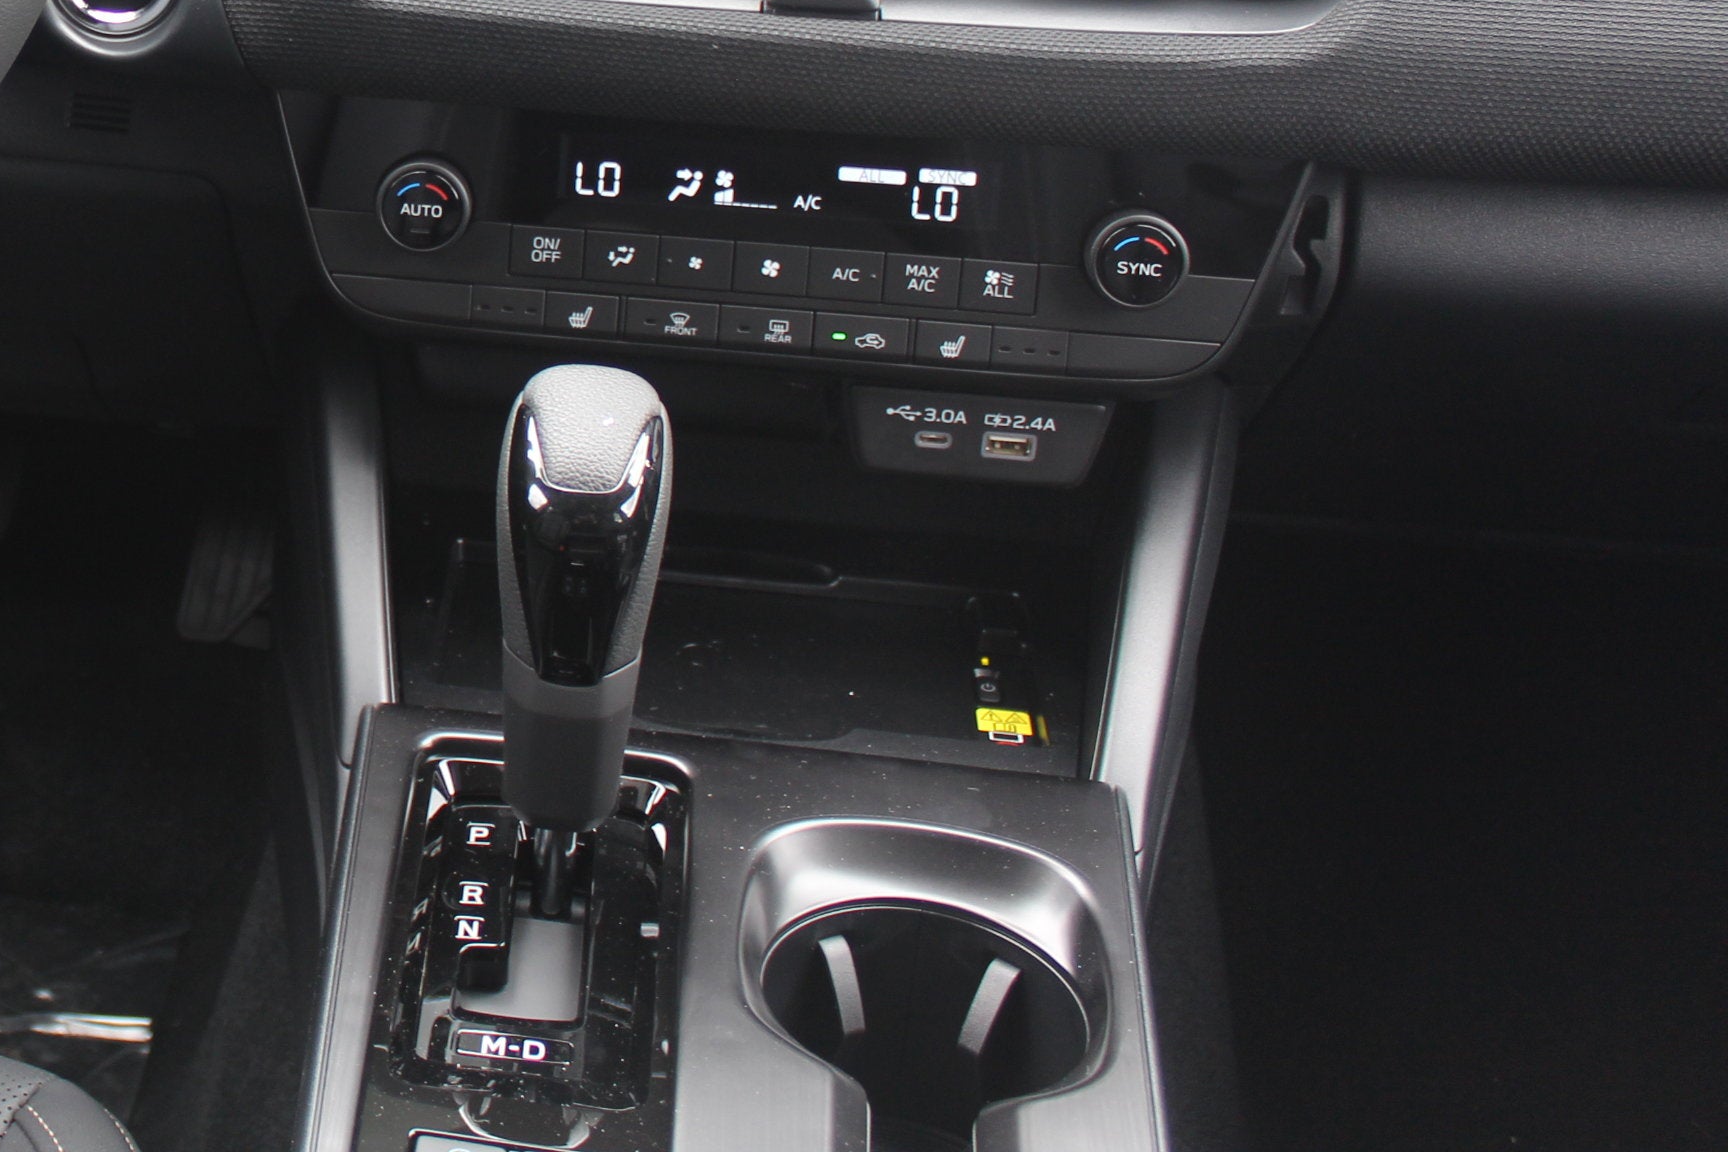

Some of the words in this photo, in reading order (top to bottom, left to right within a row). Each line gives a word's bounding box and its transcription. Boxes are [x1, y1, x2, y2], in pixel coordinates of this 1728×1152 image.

[793, 194, 822, 211] A/C
[400, 203, 443, 219] AUTO
[532, 236, 560, 251] ON/
[530, 249, 561, 263] OFF
[832, 266, 860, 282] A/C
[905, 264, 940, 279] MAX
[1116, 260, 1163, 278] SYNC
[907, 278, 936, 293] A/C
[982, 285, 1014, 299] ALL
[663, 325, 697, 337] FRONT
[764, 332, 792, 344] REAR
[923, 408, 967, 425] 3.0A
[1011, 415, 1056, 432] 2.4A
[469, 826, 490, 844] P
[462, 885, 484, 904] R
[457, 919, 480, 938] N
[480, 1035, 547, 1062] M-D
